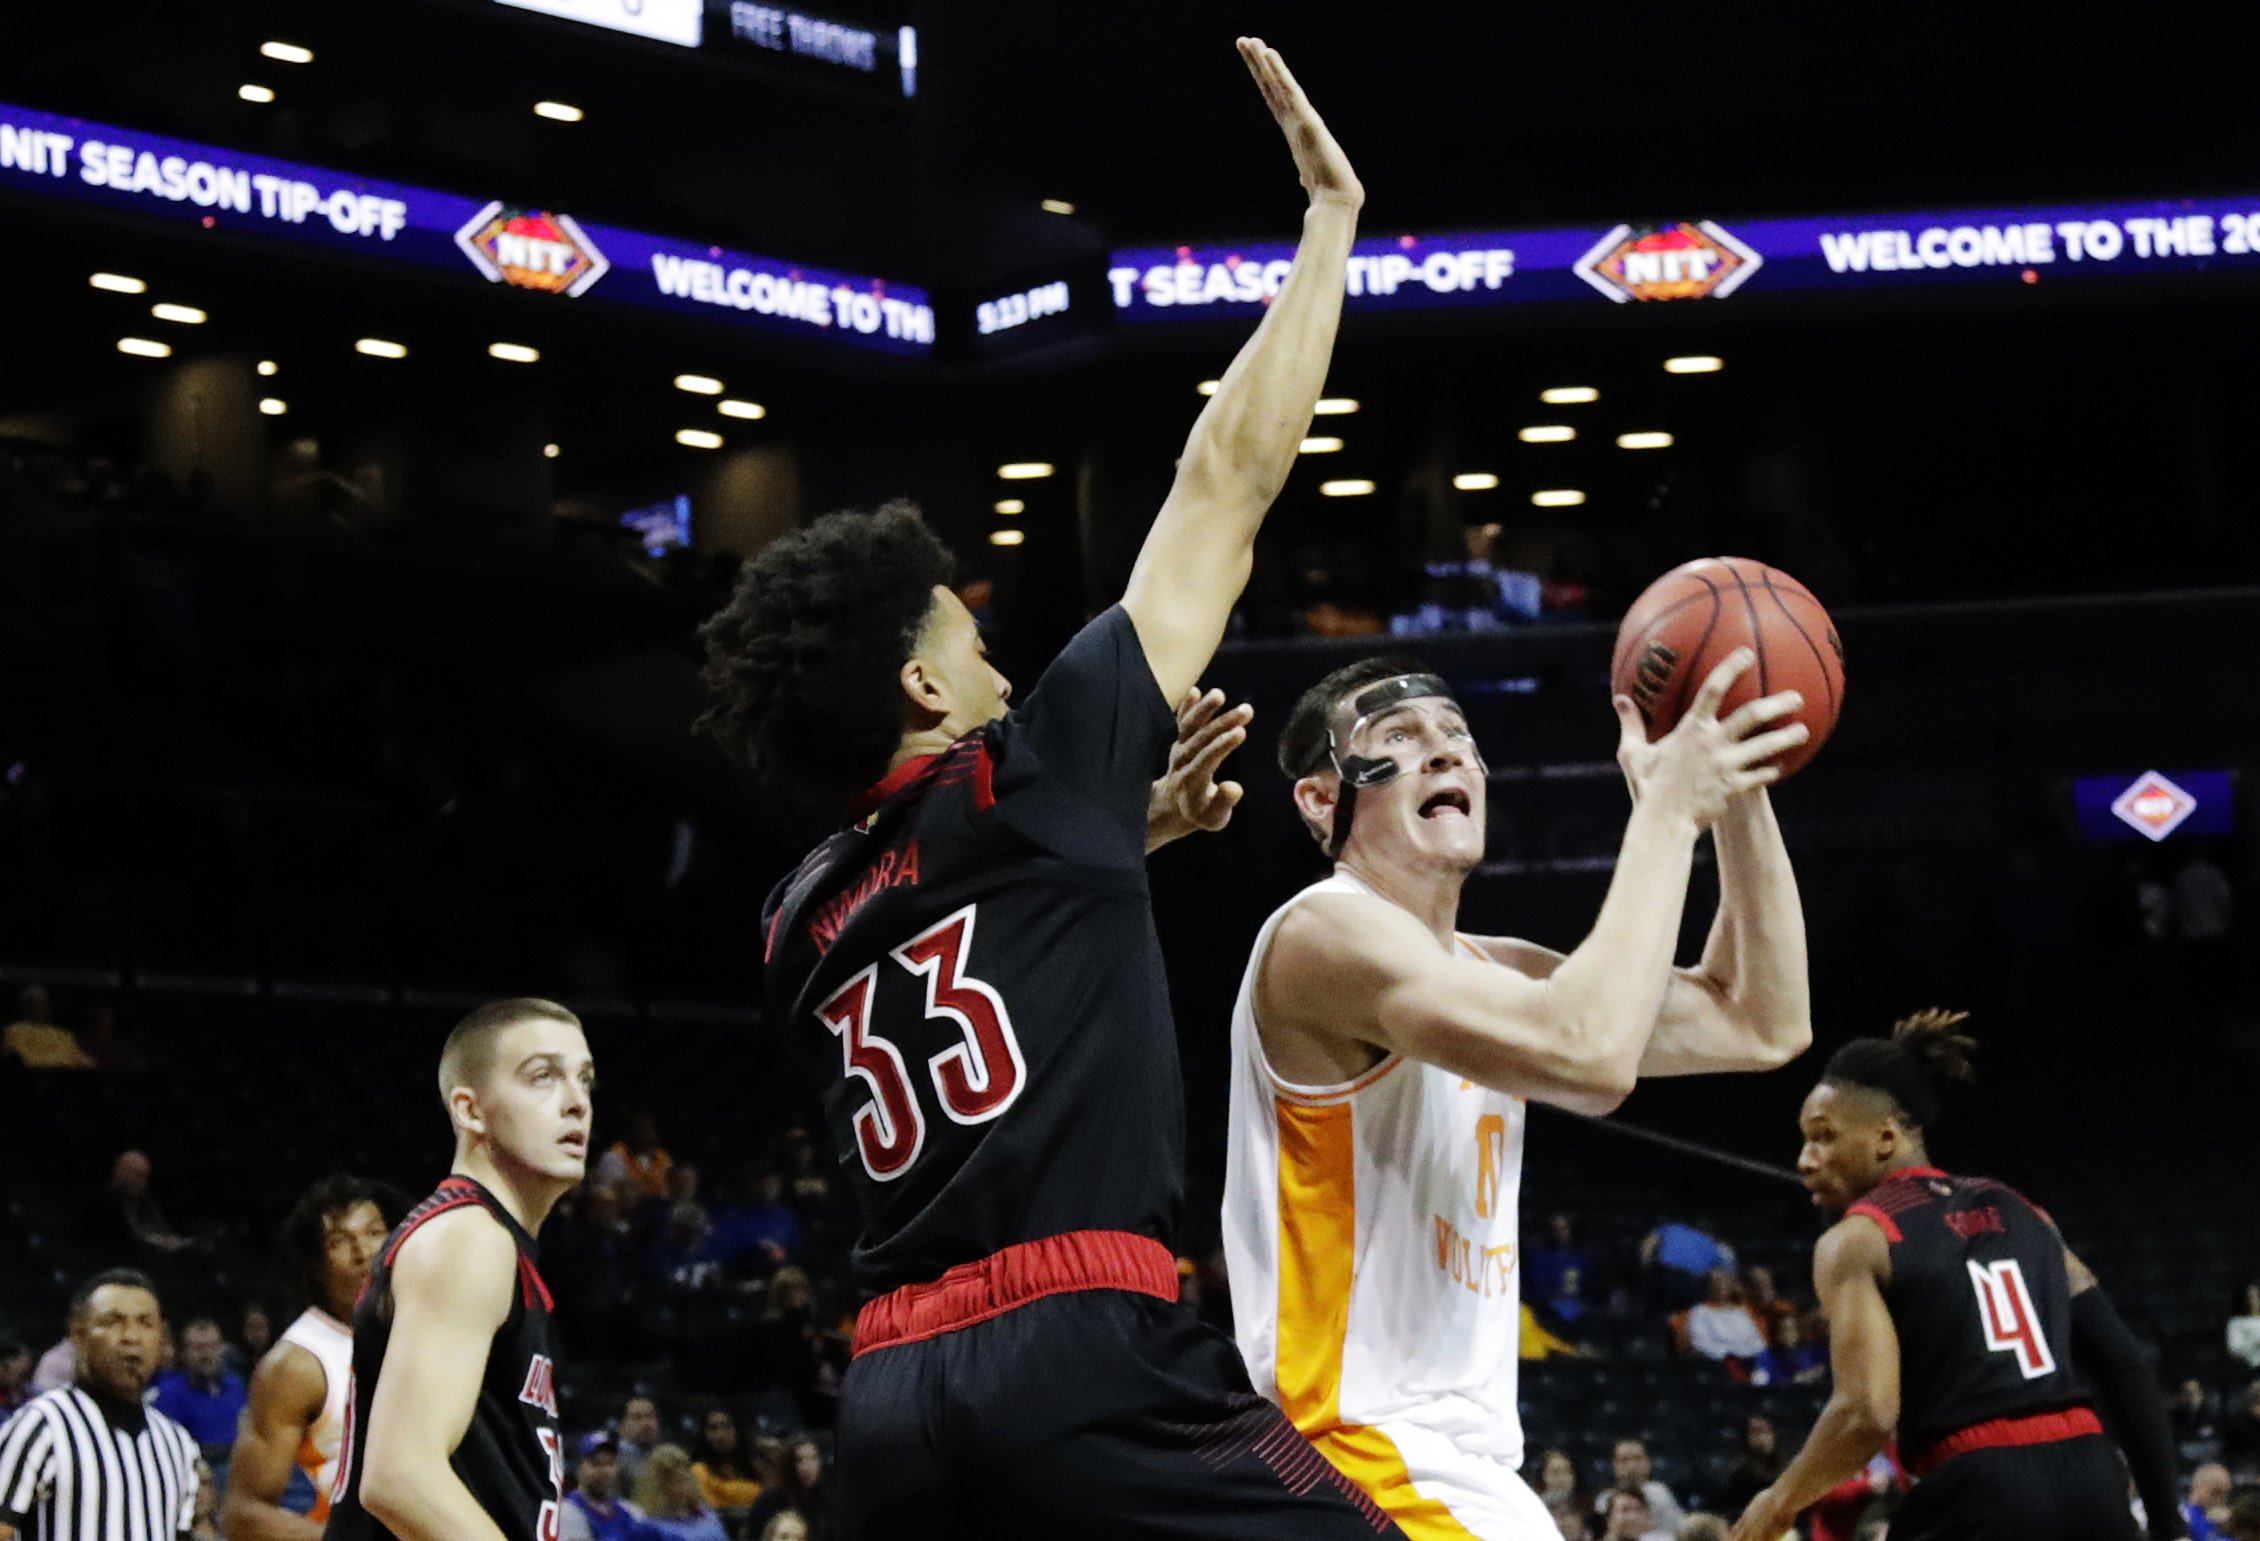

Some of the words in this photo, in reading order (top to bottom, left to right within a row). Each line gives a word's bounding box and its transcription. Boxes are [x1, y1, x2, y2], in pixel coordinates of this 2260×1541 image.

[731, 1, 784, 50] FREE
[0, 124, 73, 178] NIT
[80, 140, 251, 213] SEASON
[252, 174, 406, 241] TIP-OFF
[498, 232, 574, 276] NIT
[1346, 249, 1514, 296] TIP-OFF
[1624, 248, 1718, 284] NIT
[1820, 223, 2055, 273] WELCOME
[2056, 219, 2124, 261] TO
[2124, 215, 2216, 258] THE
[652, 253, 832, 325] WELCOME
[831, 288, 882, 334] TO
[813, 903, 1027, 1182] 33
[1966, 1258, 2057, 1379] 4
